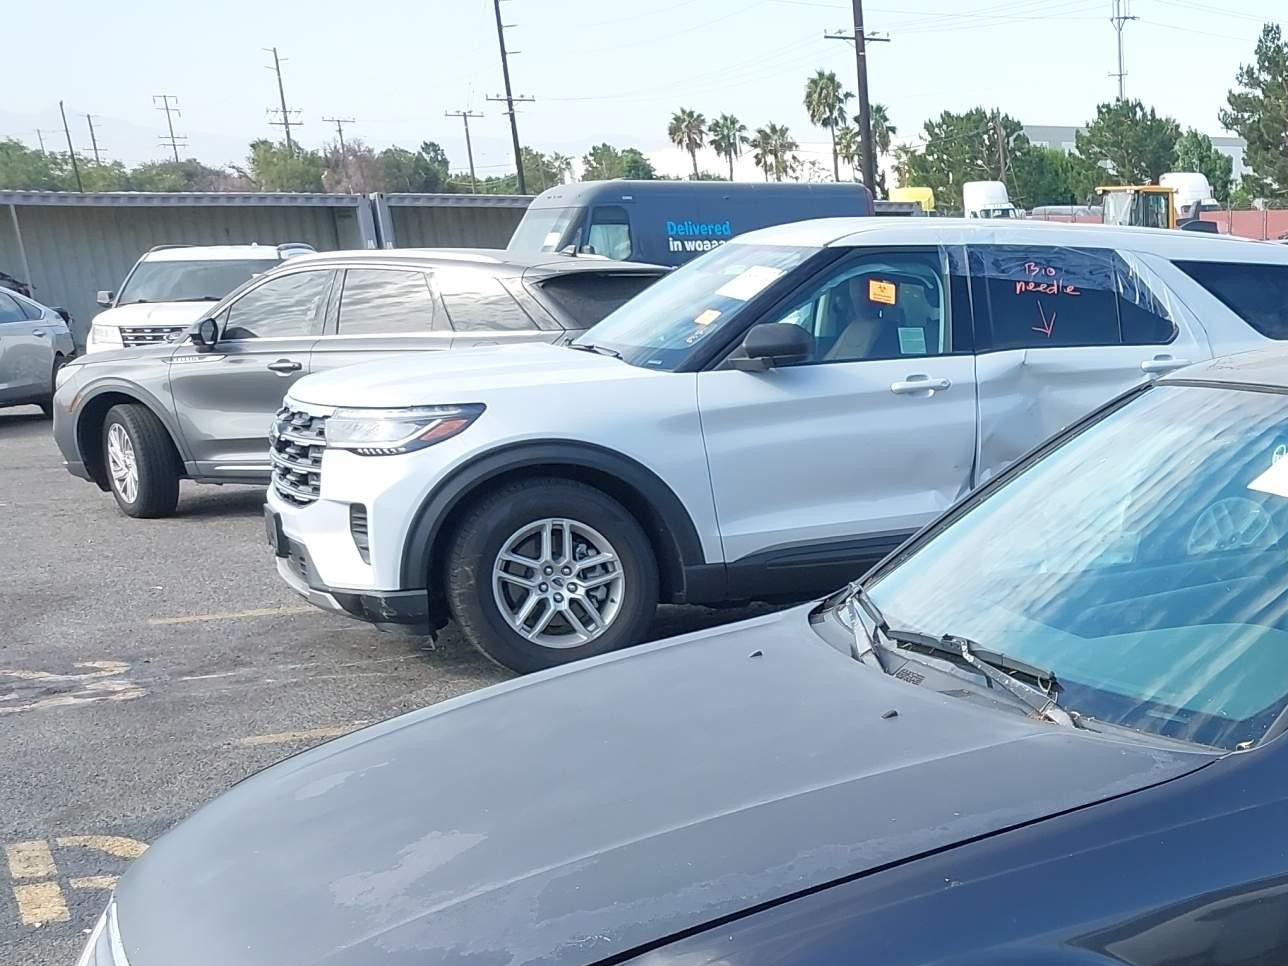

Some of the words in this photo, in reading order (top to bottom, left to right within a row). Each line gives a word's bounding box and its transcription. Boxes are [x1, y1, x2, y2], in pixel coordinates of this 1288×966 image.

[666, 221, 731, 235] Delivered
[668, 237, 683, 252] in
[1015, 279, 1080, 296] needle
